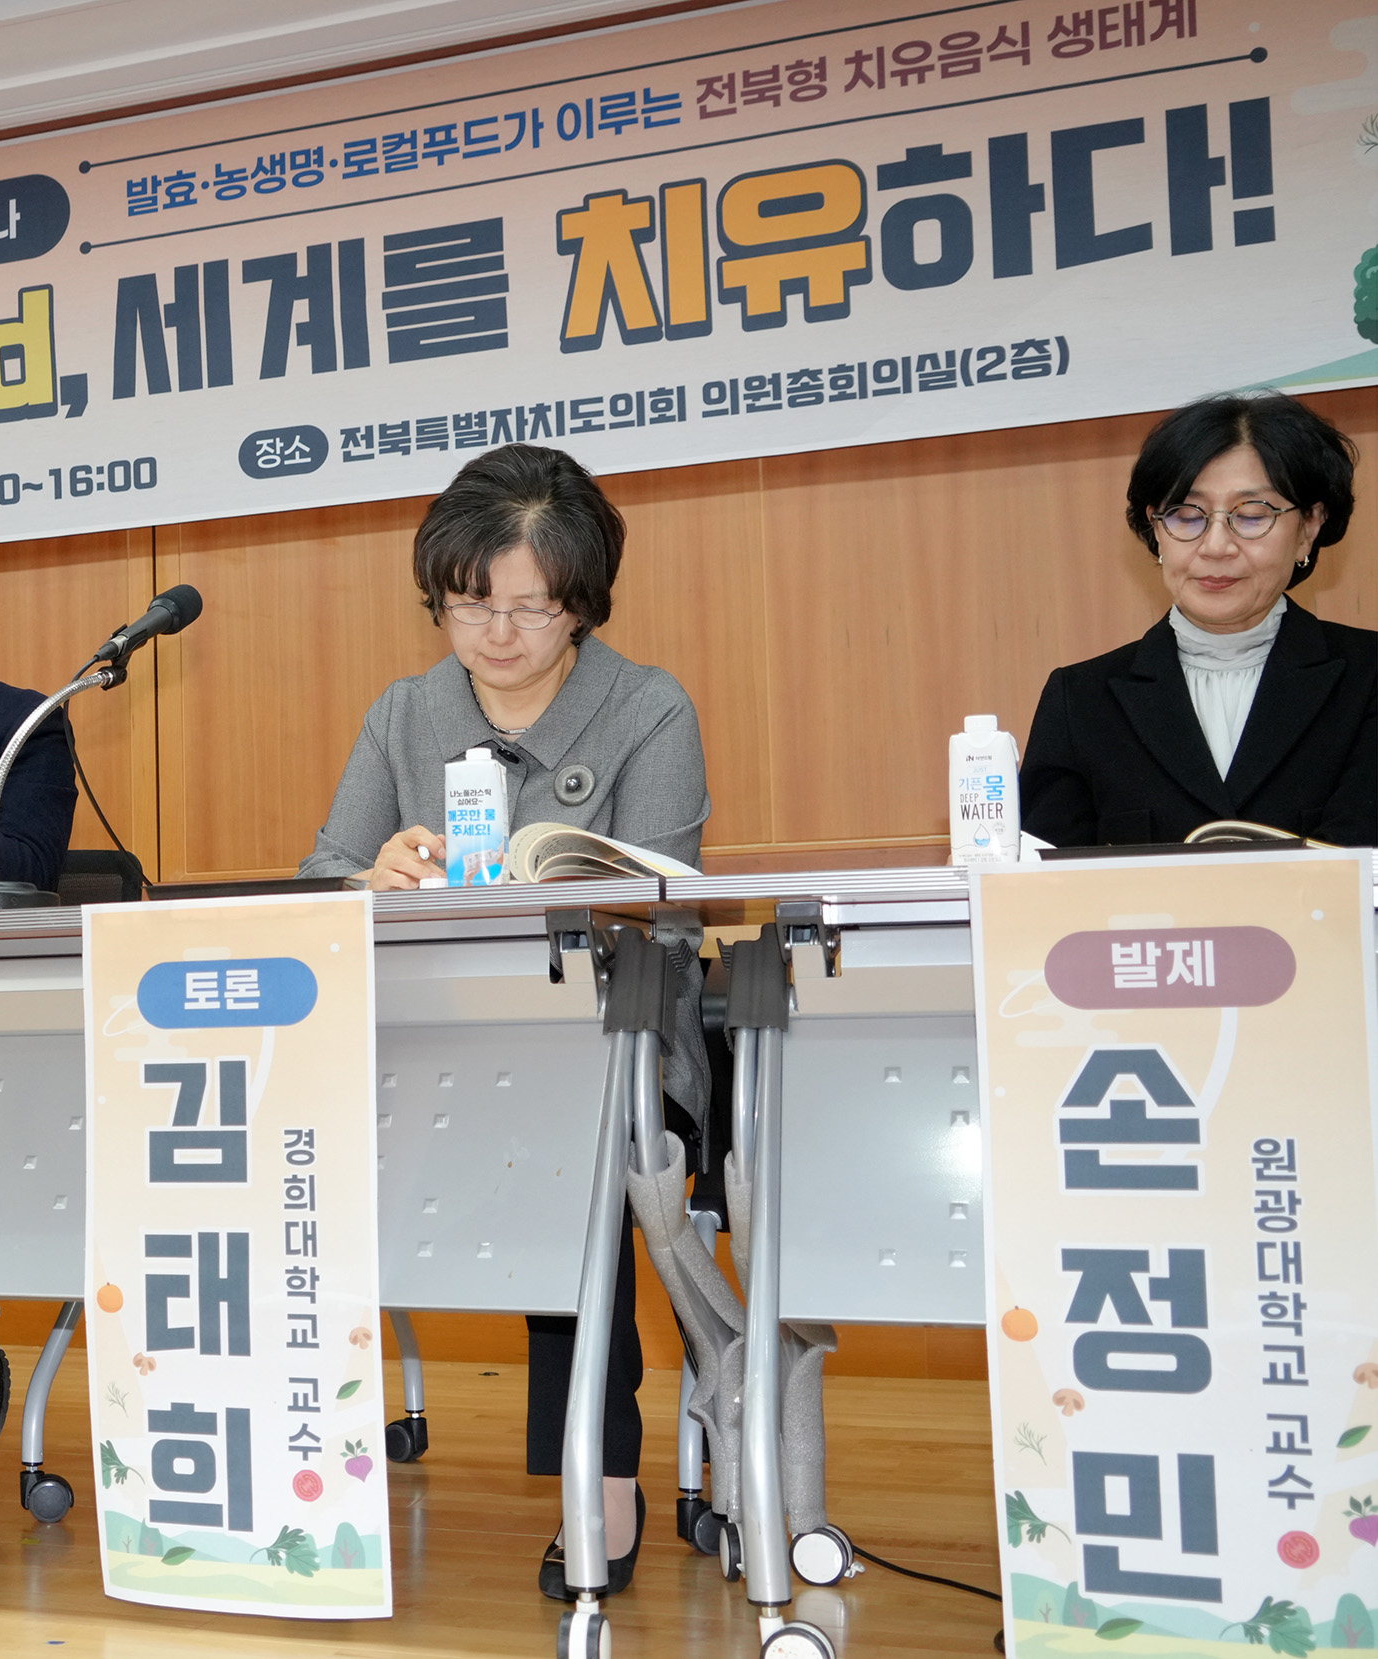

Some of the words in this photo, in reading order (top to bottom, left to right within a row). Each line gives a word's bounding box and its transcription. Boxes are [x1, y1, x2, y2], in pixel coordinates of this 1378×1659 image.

[126, 107, 543, 217] 발효·농생명·로컬푸드가
[556, 88, 683, 142] 이루는
[695, 54, 828, 119] 전북형
[844, 21, 1032, 94] 치유음식
[1047, 0, 1199, 60] 생태계
[112, 217, 510, 400] 세계를
[556, 96, 1277, 353] 치유하다!
[339, 385, 688, 464] 전북특별자치도의회
[701, 336, 1071, 419] 의원총회의실(2층)
[255, 436, 312, 469] 장소
[448, 809, 481, 822] 깨끗한
[452, 824, 491, 837] 주세요!
[959, 793, 979, 803] DEEP
[960, 802, 1003, 820] WATER
[983, 775, 1006, 801] 물
[183, 968, 261, 1011] 토론
[1109, 939, 1218, 990] 발제
[282, 1127, 321, 1352] 경희대학교
[1251, 1137, 1310, 1389] 원광대학교
[143, 1059, 254, 1533] 김태희
[1058, 1048, 1224, 1604] 손정민
[286, 1377, 323, 1462] 교수
[1265, 1412, 1316, 1512] 교수
